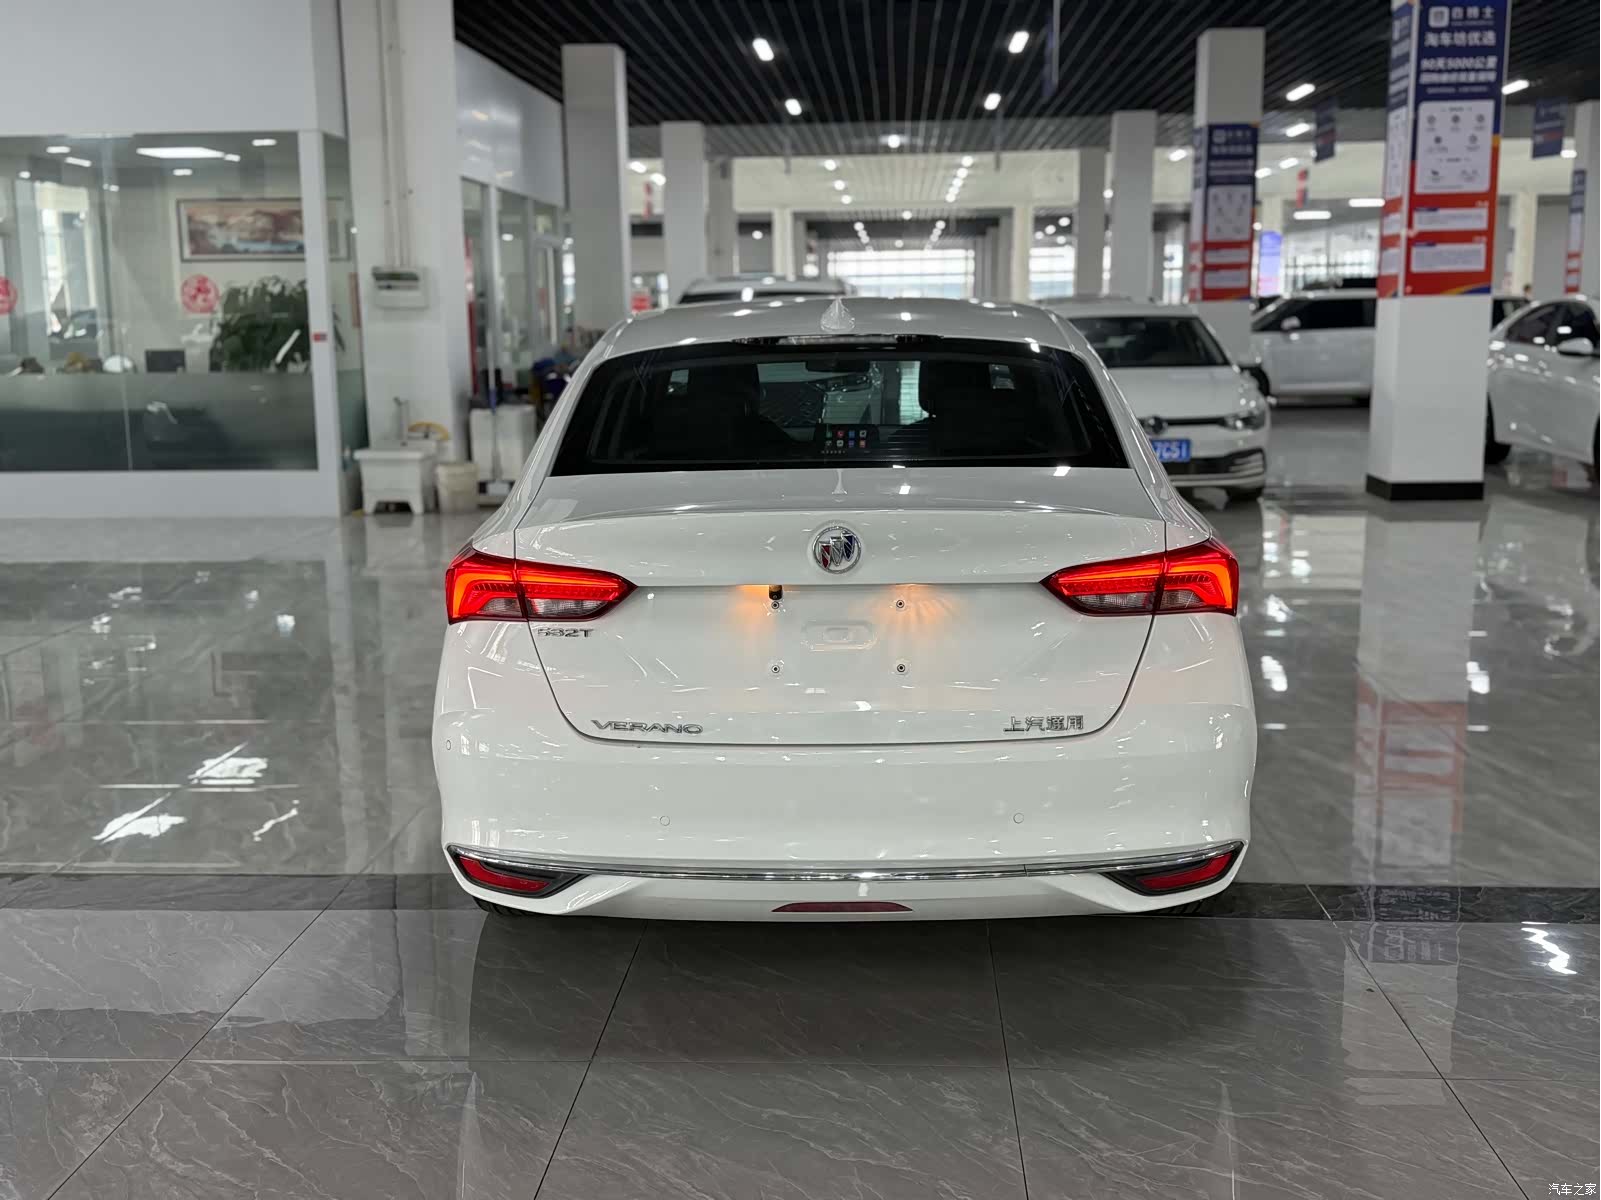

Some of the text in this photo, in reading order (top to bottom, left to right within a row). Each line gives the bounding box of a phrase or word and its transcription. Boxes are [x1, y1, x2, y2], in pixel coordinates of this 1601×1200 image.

[590, 719, 703, 734] VERANO
[1003, 715, 1084, 732] 上汽通用
